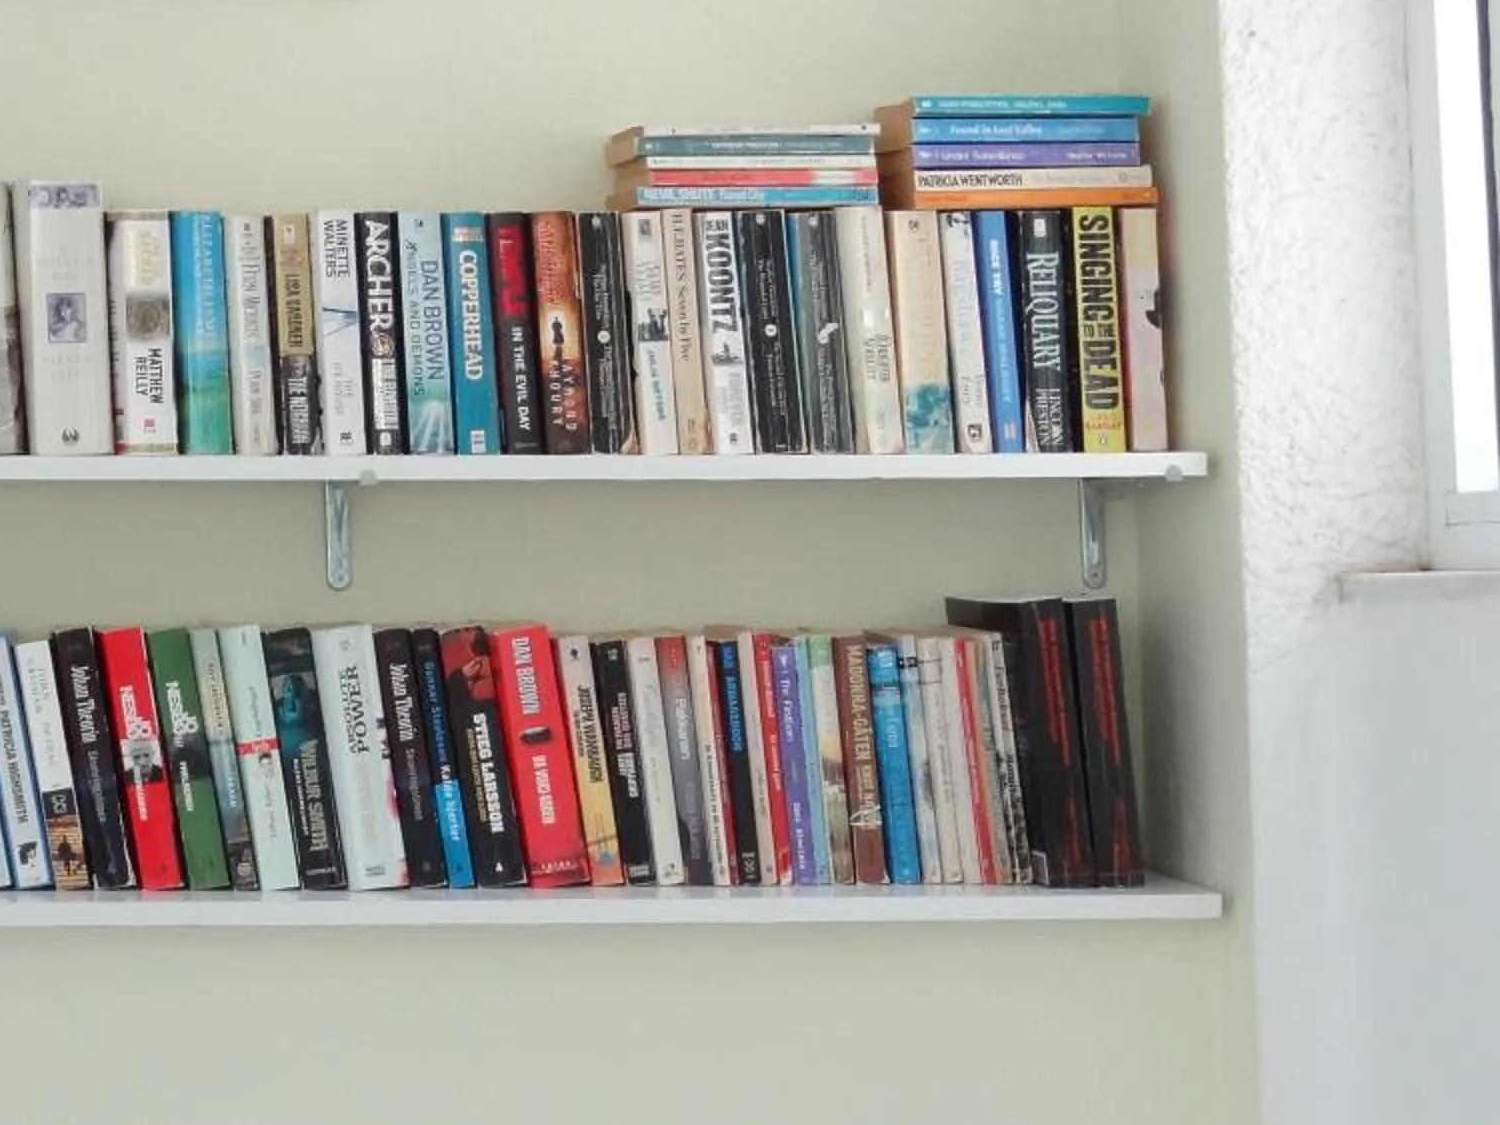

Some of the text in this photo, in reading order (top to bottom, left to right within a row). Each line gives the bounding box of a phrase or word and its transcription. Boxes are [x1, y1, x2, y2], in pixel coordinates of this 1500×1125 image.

[323, 220, 336, 277] WALTERS
[336, 219, 349, 277] MINETTE
[364, 220, 392, 334] ARCHER
[1078, 215, 1110, 321] SINGING
[677, 286, 689, 320] Seven
[705, 234, 738, 333] KOONTZ
[1026, 251, 1060, 371] RELIQUARY
[409, 300, 422, 330] AND
[420, 260, 444, 380] DAN BROWN
[459, 250, 483, 380] COPPERHEAD
[511, 327, 523, 342] IN
[135, 357, 148, 396] REILLY
[148, 348, 164, 404] MATTHEW
[411, 334, 425, 396] DEMONS
[514, 346, 526, 371] THE
[515, 374, 528, 403] EVIL
[1083, 341, 1119, 410] DEAD
[518, 407, 531, 430] DAY
[347, 665, 369, 753] POWER
[301, 739, 321, 799] WILBUR
[473, 713, 489, 759] STIEG
[482, 762, 504, 833] LARSSON
